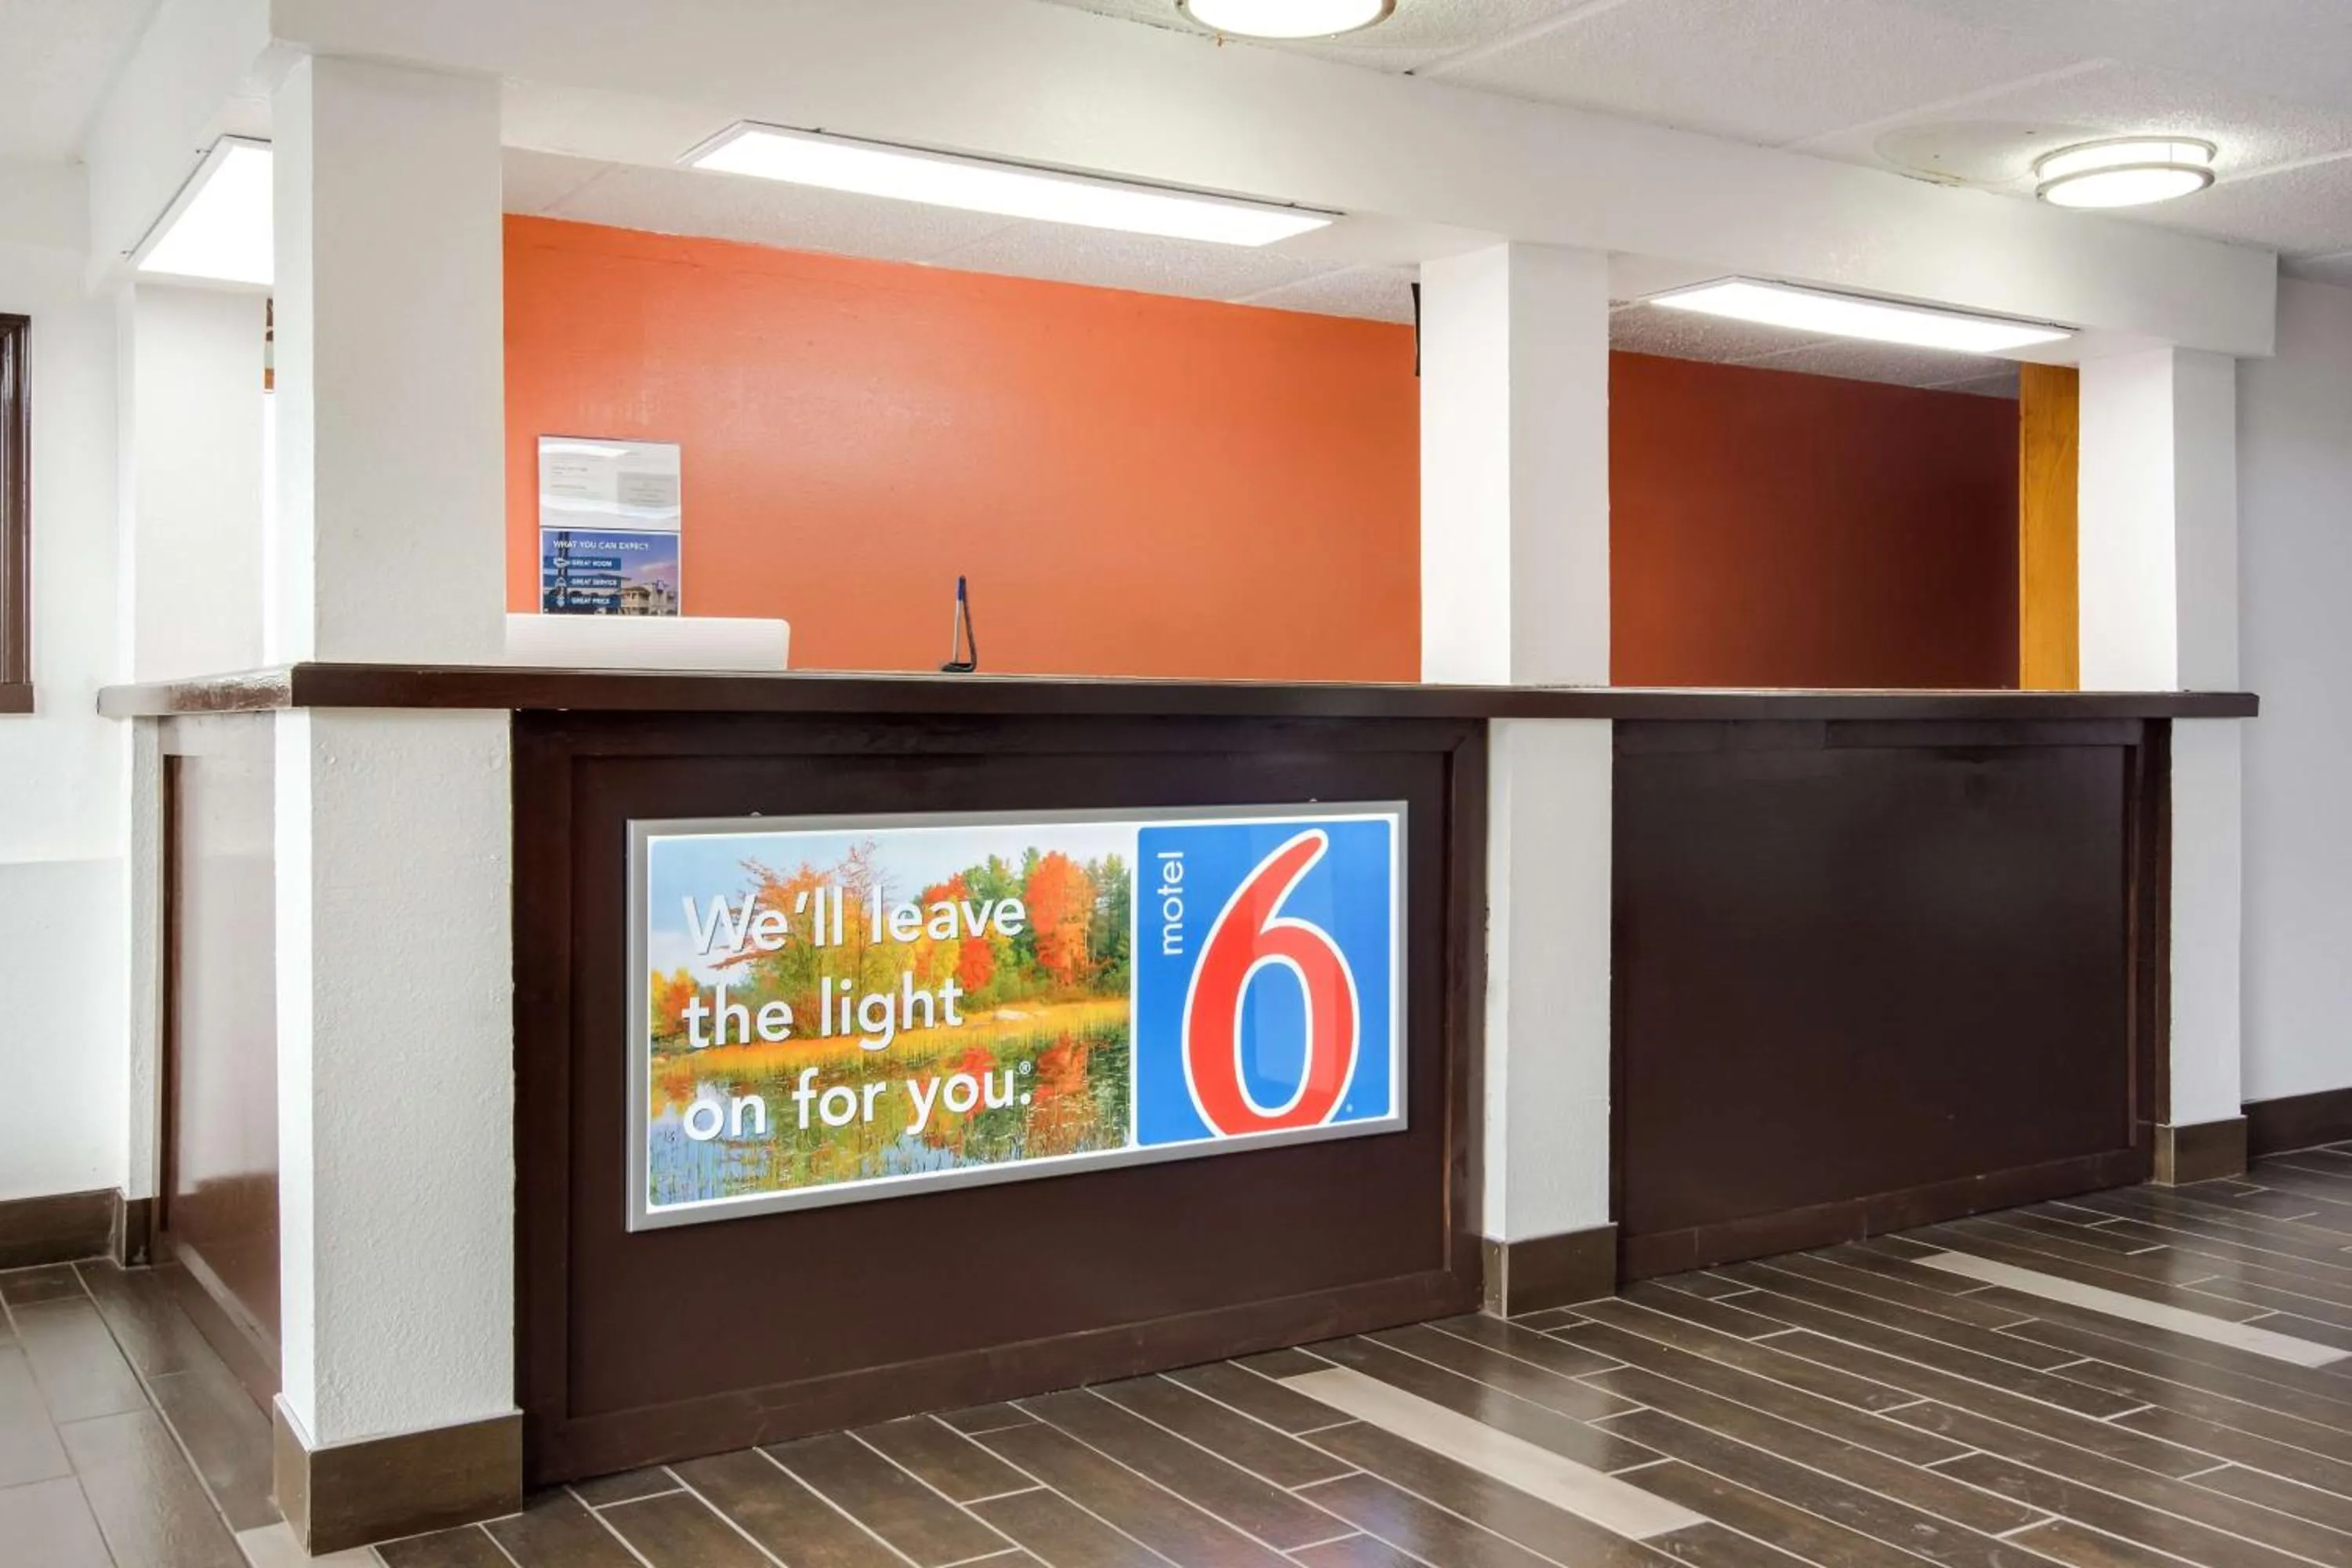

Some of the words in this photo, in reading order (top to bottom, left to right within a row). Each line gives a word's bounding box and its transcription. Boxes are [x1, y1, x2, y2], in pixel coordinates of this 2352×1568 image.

[553, 540, 578, 549] WHAT
[598, 541, 617, 550] CAN
[682, 886, 844, 955] We'll
[871, 885, 1025, 943] leave
[1157, 852, 1184, 955] motel
[682, 985, 793, 1048] the
[821, 971, 964, 1051] light
[1182, 829, 1359, 1138] 6
[683, 1094, 766, 1141] on
[792, 1067, 887, 1130] for
